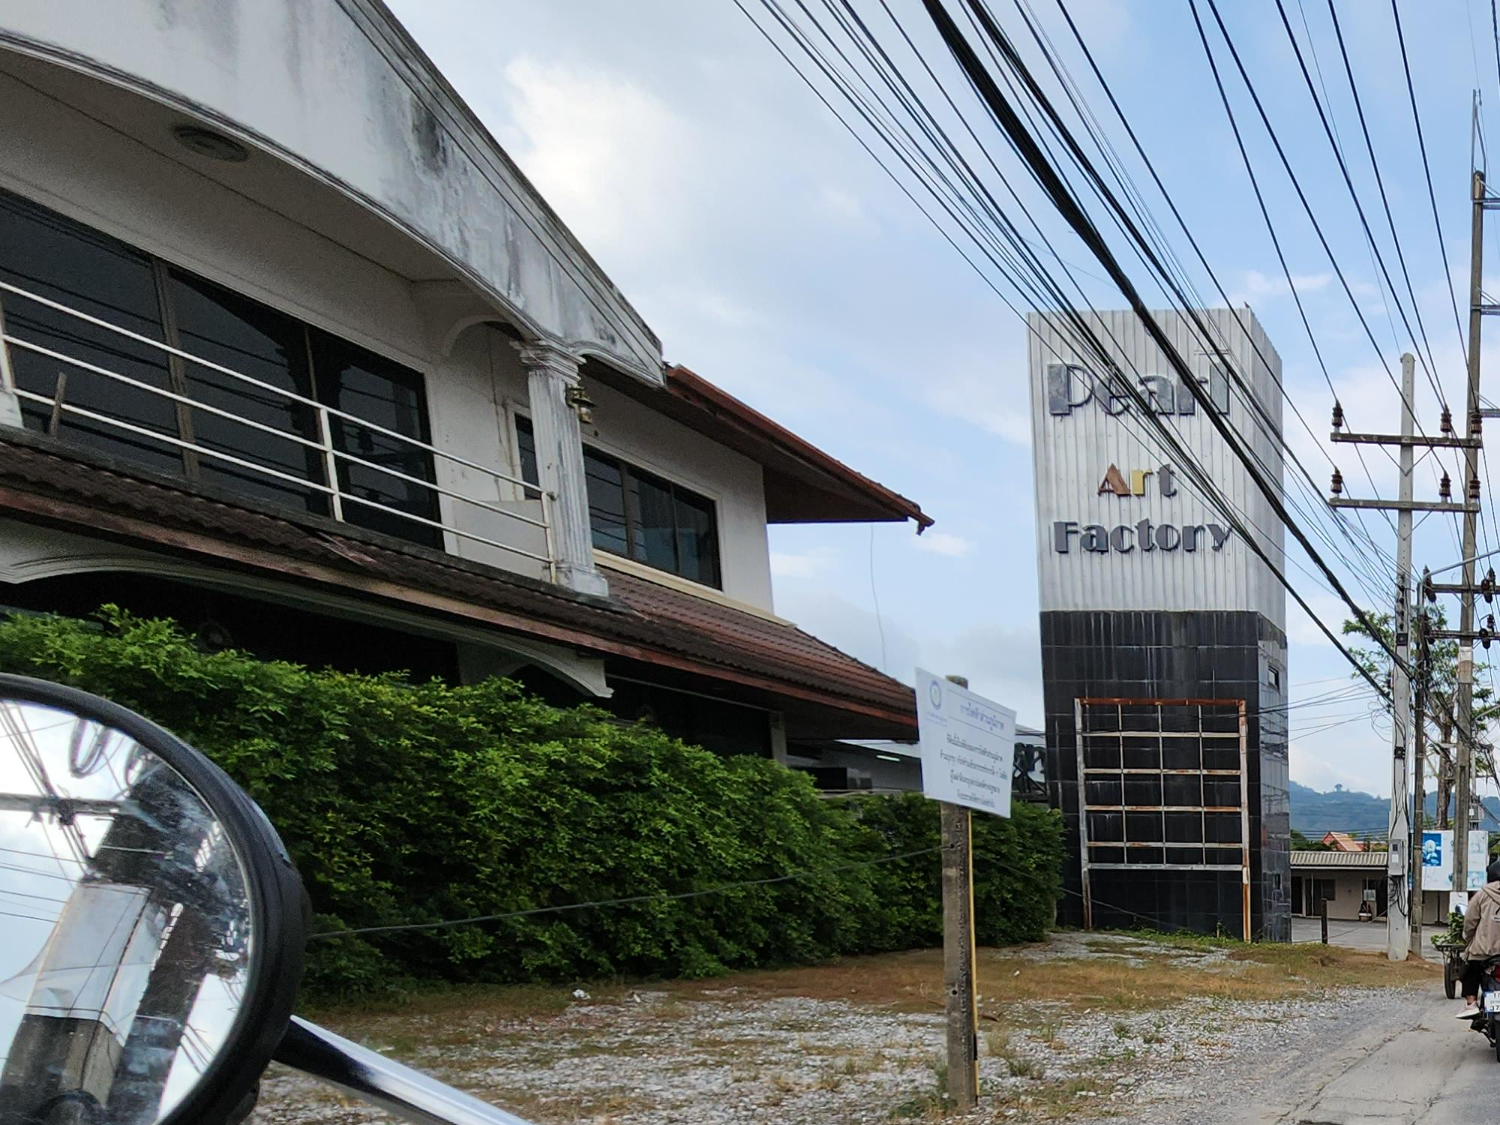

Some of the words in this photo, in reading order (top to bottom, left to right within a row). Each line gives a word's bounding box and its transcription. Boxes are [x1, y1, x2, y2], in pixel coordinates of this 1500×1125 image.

[1047, 362, 1231, 416] Pearl
[1097, 463, 1178, 498] Art
[1053, 518, 1233, 554] Factory
